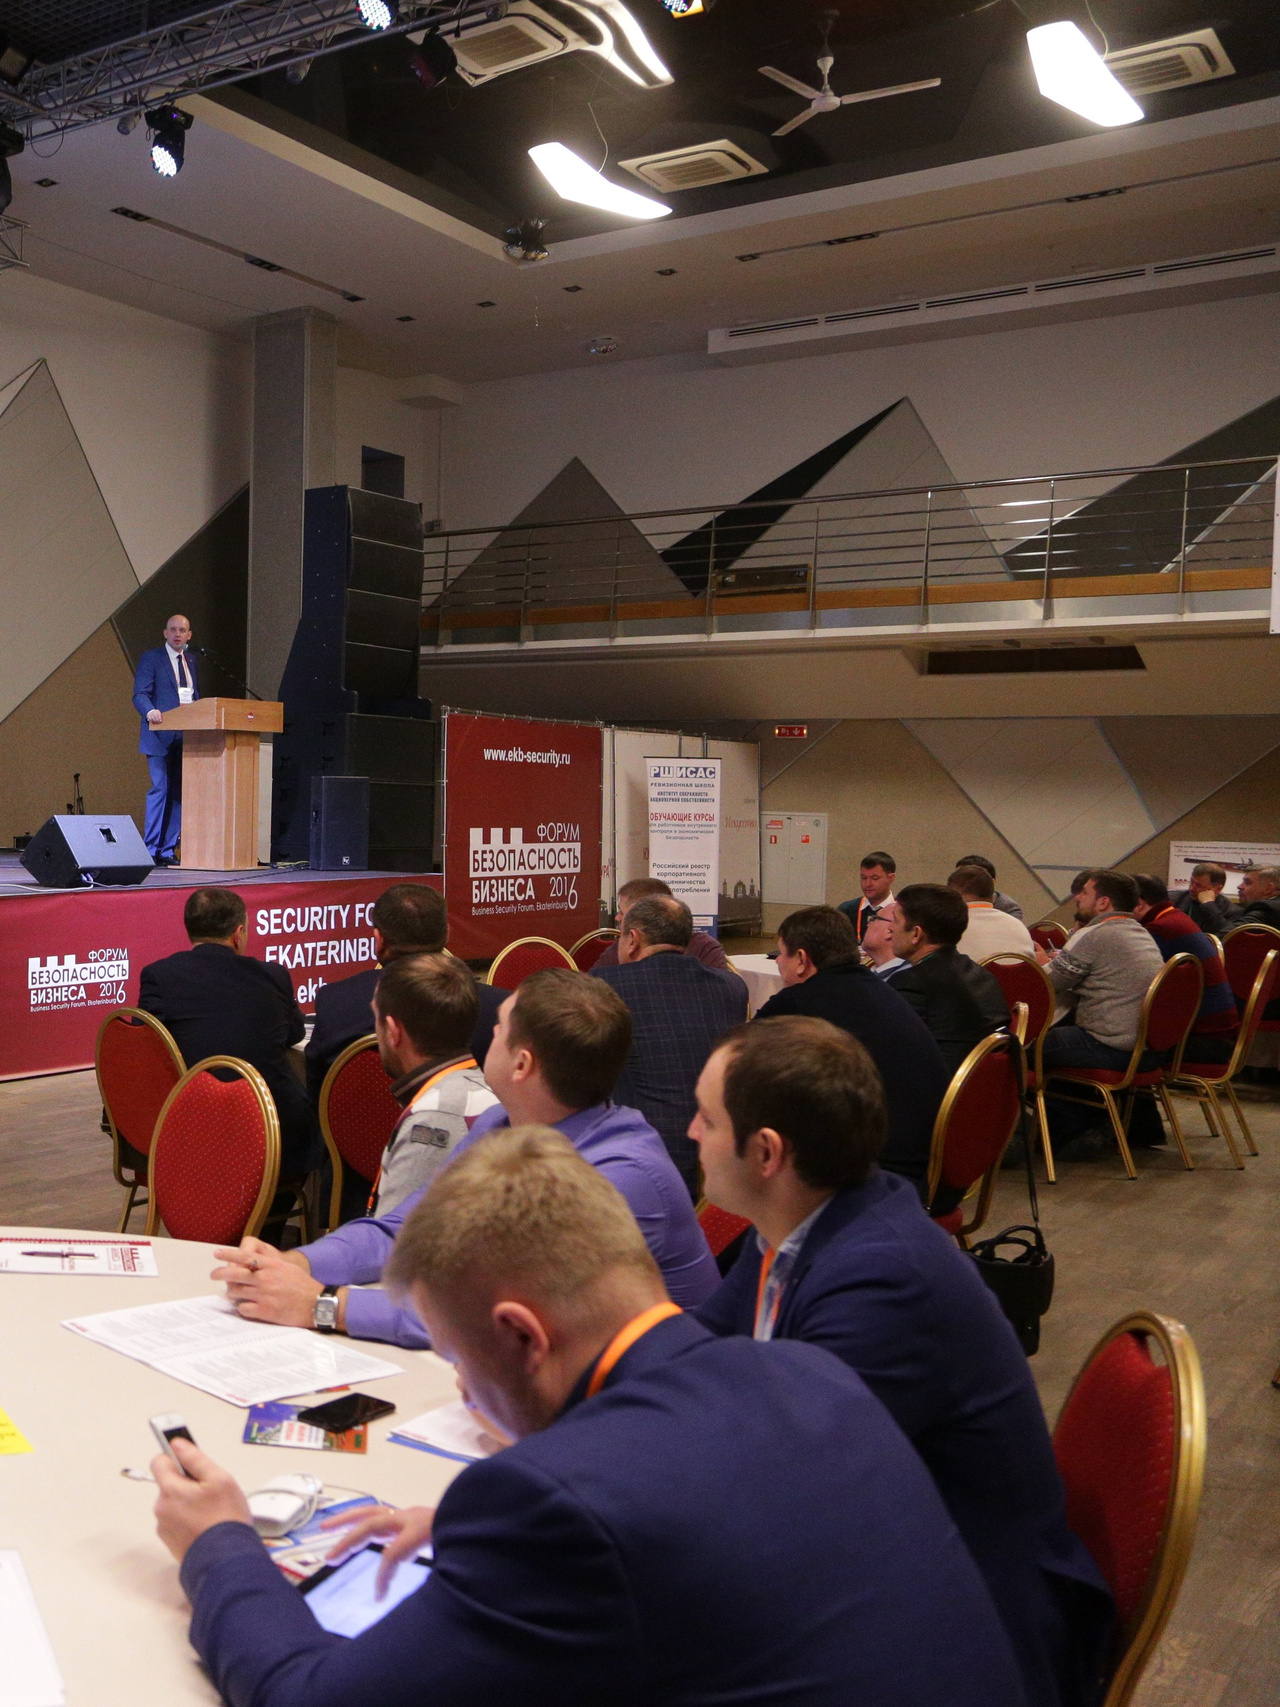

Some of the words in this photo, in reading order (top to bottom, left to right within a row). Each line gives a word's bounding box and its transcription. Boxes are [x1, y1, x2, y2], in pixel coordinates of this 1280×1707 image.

[483, 747, 571, 768] www.ekb-security.ru
[650, 812, 692, 822] ОБУЧАЮЩИЕ
[693, 812, 715, 821] КУРСЫ
[536, 822, 580, 842] ФОРУМ
[472, 847, 580, 873] БЕЗОПАСНОСТЬ
[472, 877, 536, 904] БИЗНЕСА
[549, 875, 578, 910] 2016
[256, 904, 350, 936] SECURITY
[471, 905, 495, 917] Business
[495, 904, 517, 915] Security
[88, 948, 128, 962] ФОРУМ
[31, 964, 128, 985] БЕЗОПАСНОСТЬ
[30, 985, 87, 1005] БИЗНЕСА
[99, 981, 127, 1003] 2016
[51, 1002, 71, 1011] Security
